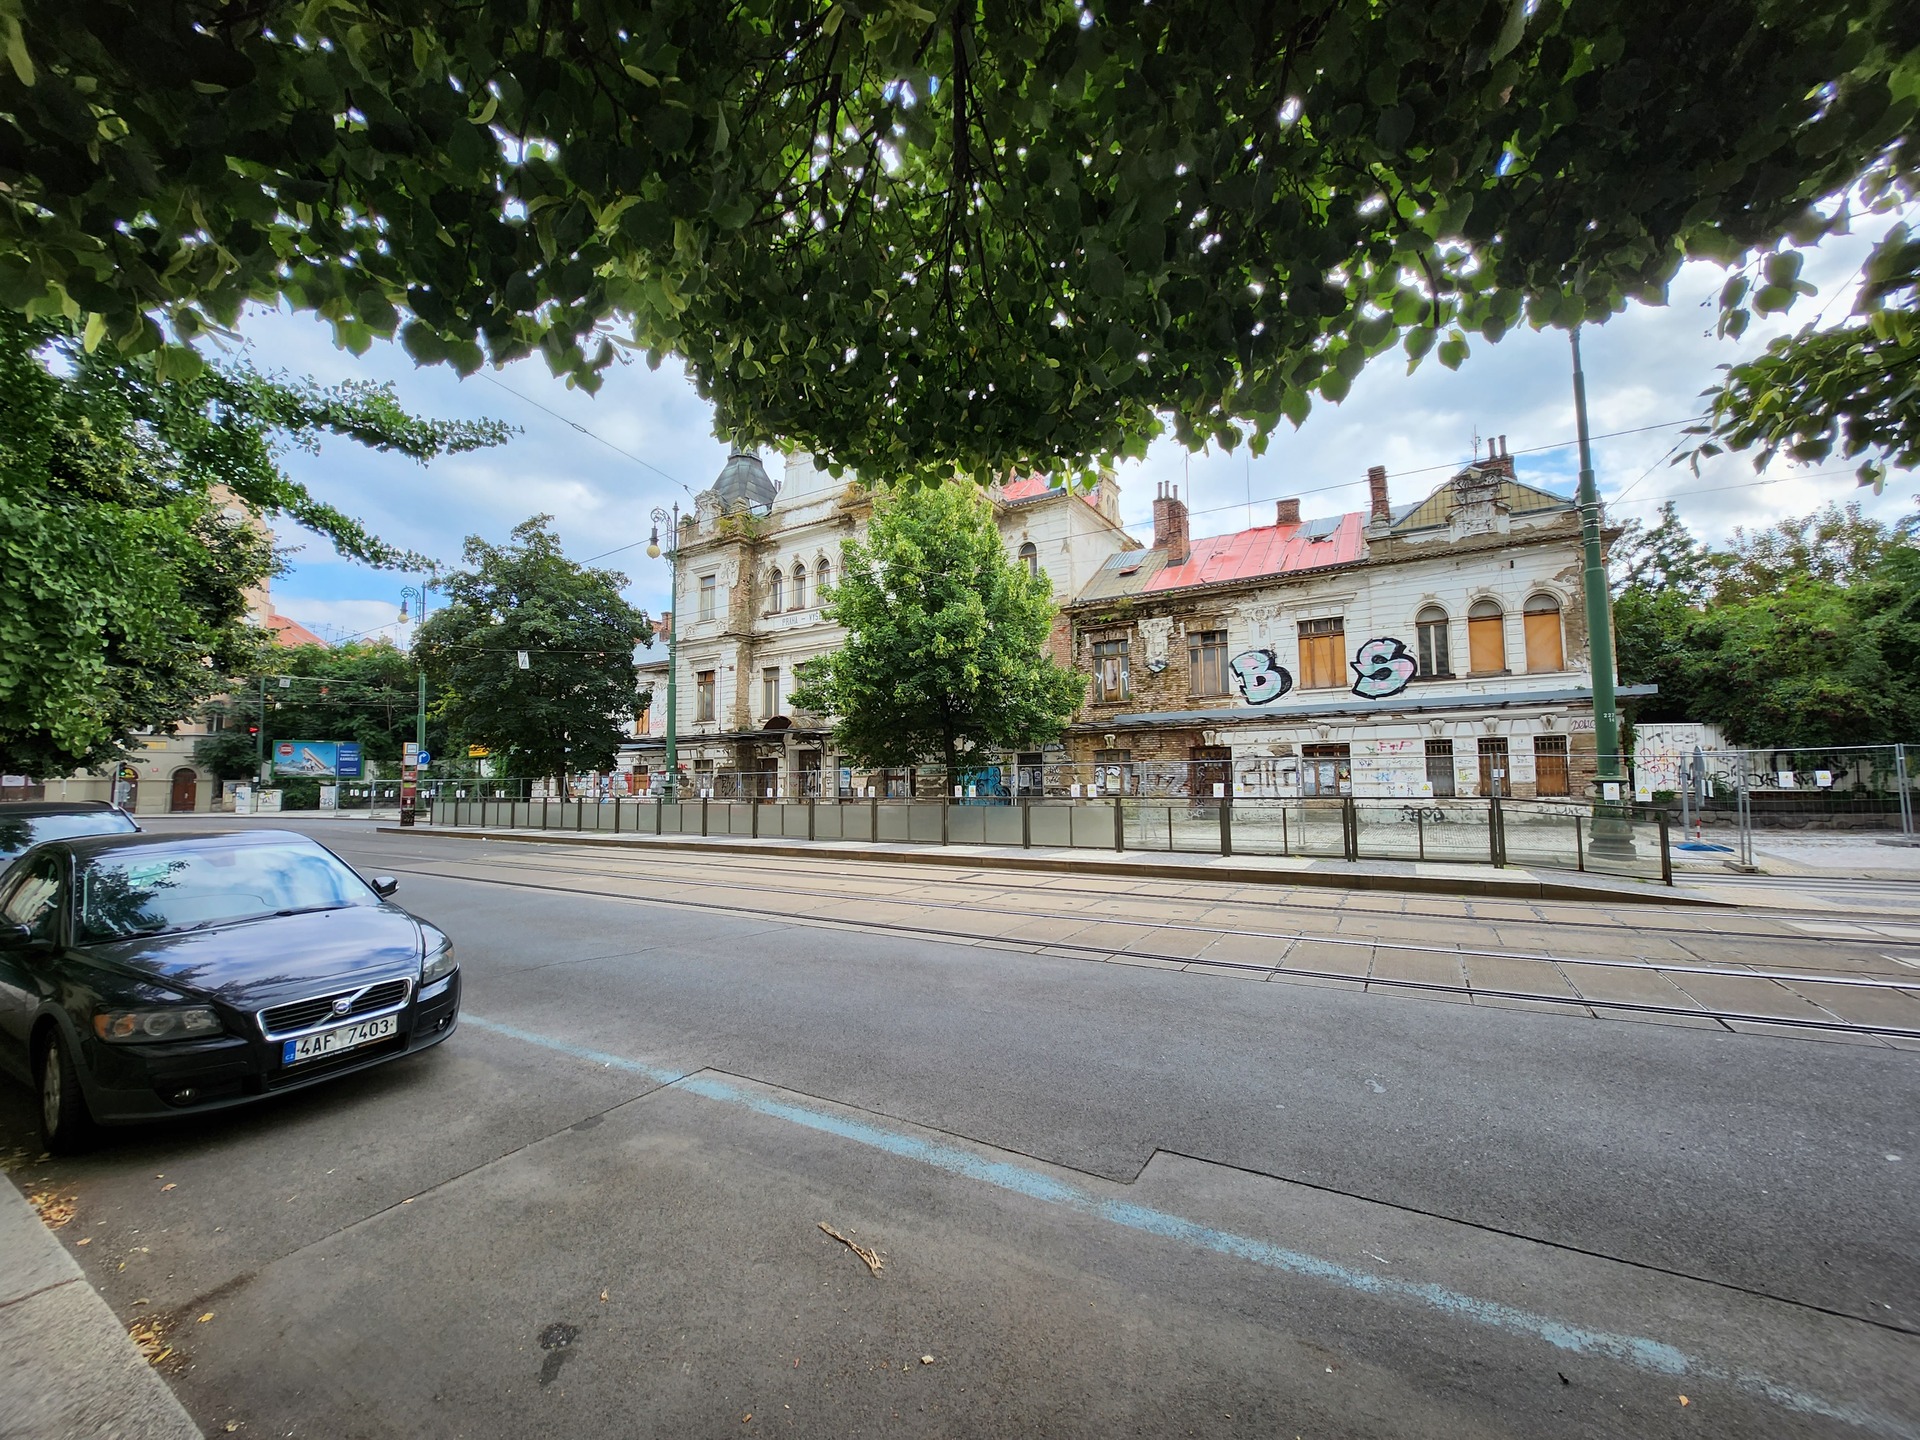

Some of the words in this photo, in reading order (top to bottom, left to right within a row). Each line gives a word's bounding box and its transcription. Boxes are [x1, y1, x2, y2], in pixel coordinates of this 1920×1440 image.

[782, 616, 799, 626] PRAHA
[300, 1034, 334, 1055] 4AF
[348, 1019, 389, 1044] 7403
